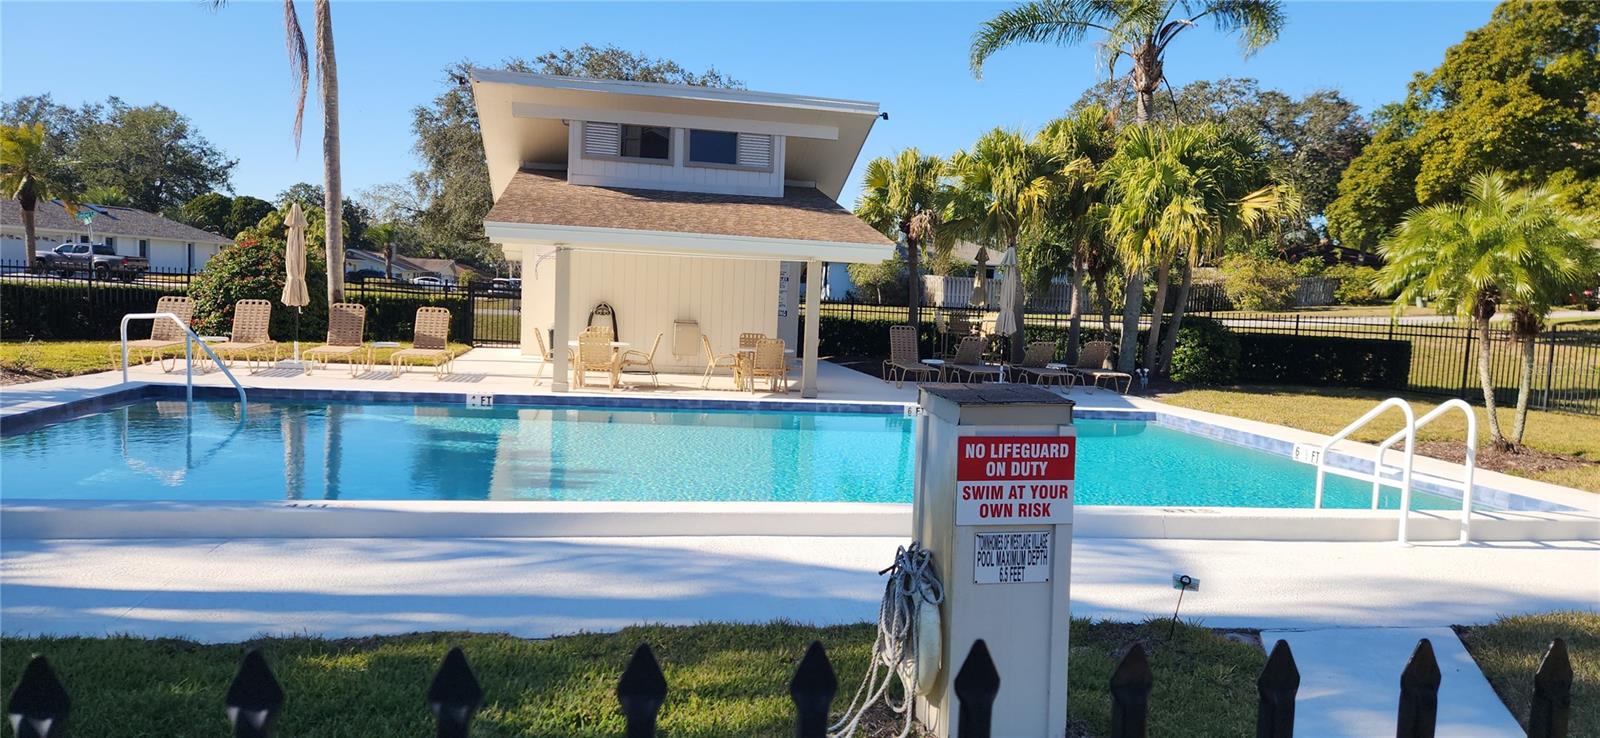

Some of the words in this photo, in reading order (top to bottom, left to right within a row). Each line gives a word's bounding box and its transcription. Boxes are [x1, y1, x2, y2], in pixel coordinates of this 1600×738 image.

[965, 443, 985, 459] NO
[990, 443, 1069, 459] LIFEGUARD
[986, 461, 1006, 477] ON
[1011, 461, 1049, 476] DUTY
[962, 485, 1003, 501] SWIM
[1008, 485, 1026, 500] AT
[1030, 485, 1068, 499] YOUR
[979, 503, 1013, 518] OWN
[1018, 503, 1051, 517] RISK
[1004, 534, 1010, 550] OF
[1031, 533, 1048, 549] VILLAGE
[977, 550, 994, 567] POOL
[996, 550, 1026, 567] MAXIMUM
[1027, 549, 1048, 566] DEPTH
[999, 566, 1009, 582] 6.5
[1010, 566, 1025, 582] FEET
